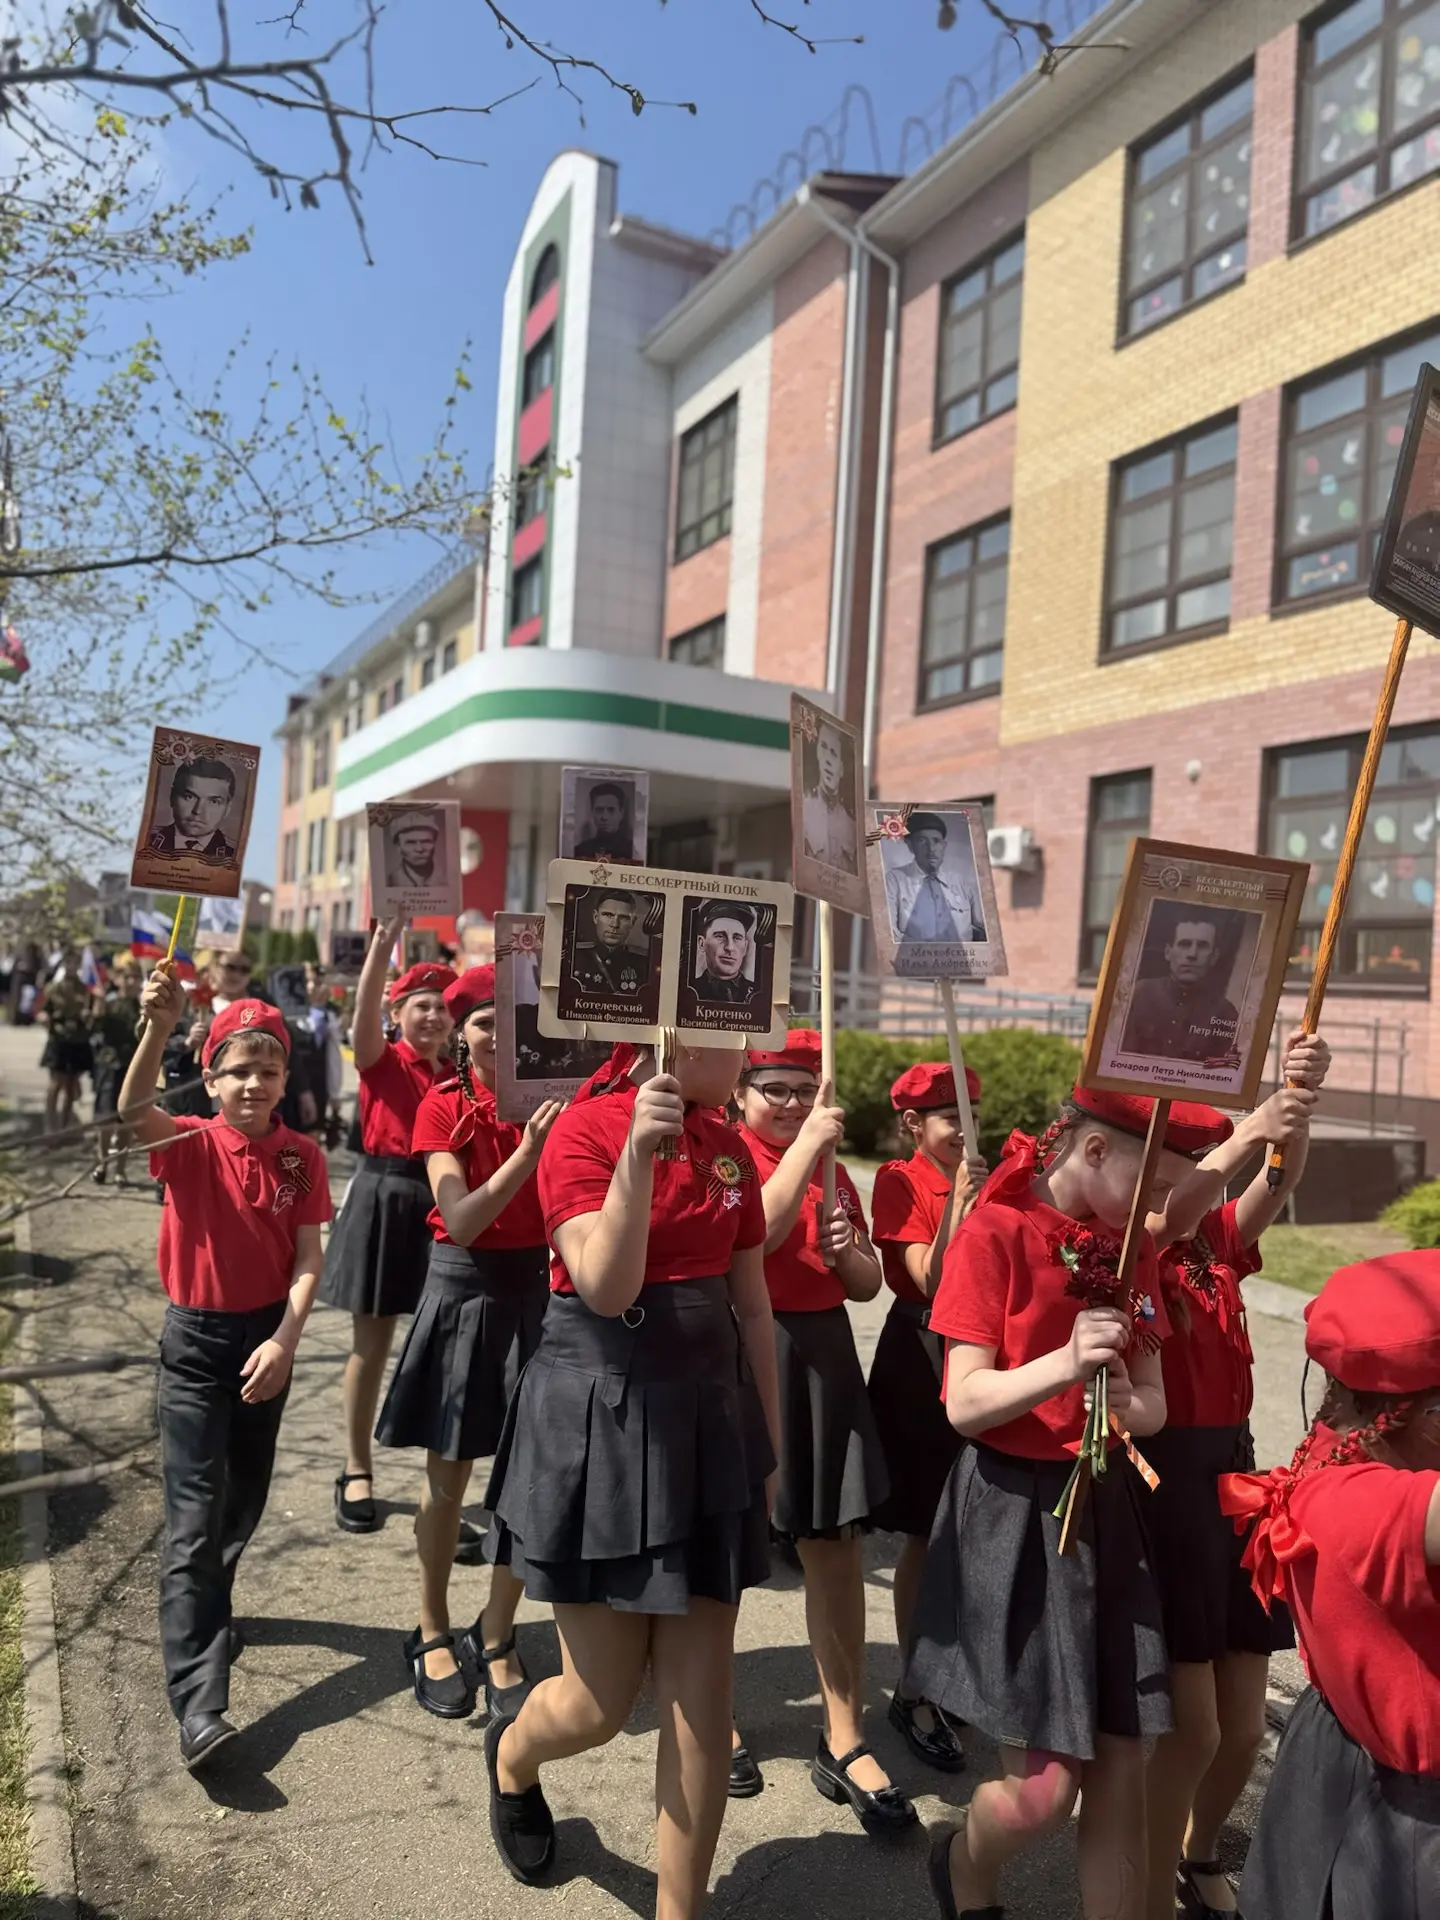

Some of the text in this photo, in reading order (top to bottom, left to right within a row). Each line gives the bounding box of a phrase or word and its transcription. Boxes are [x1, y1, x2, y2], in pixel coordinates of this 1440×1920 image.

[620, 873, 759, 897] БЕССМЕРТНЫЙ ПОЛК
[1196, 875, 1264, 892] БЕССМЕРТНЫЙ
[1197, 884, 1260, 900] ПОЛК РОССИИ
[574, 998, 643, 1013] Котелевский
[695, 1005, 752, 1021] Кротенко
[565, 1010, 650, 1025] Николай Федорович
[680, 1017, 764, 1032] Василий Сергеевич
[1189, 1025, 1211, 1037] Петр
[1110, 1060, 1233, 1083] Бочаров Петр Николаевич
